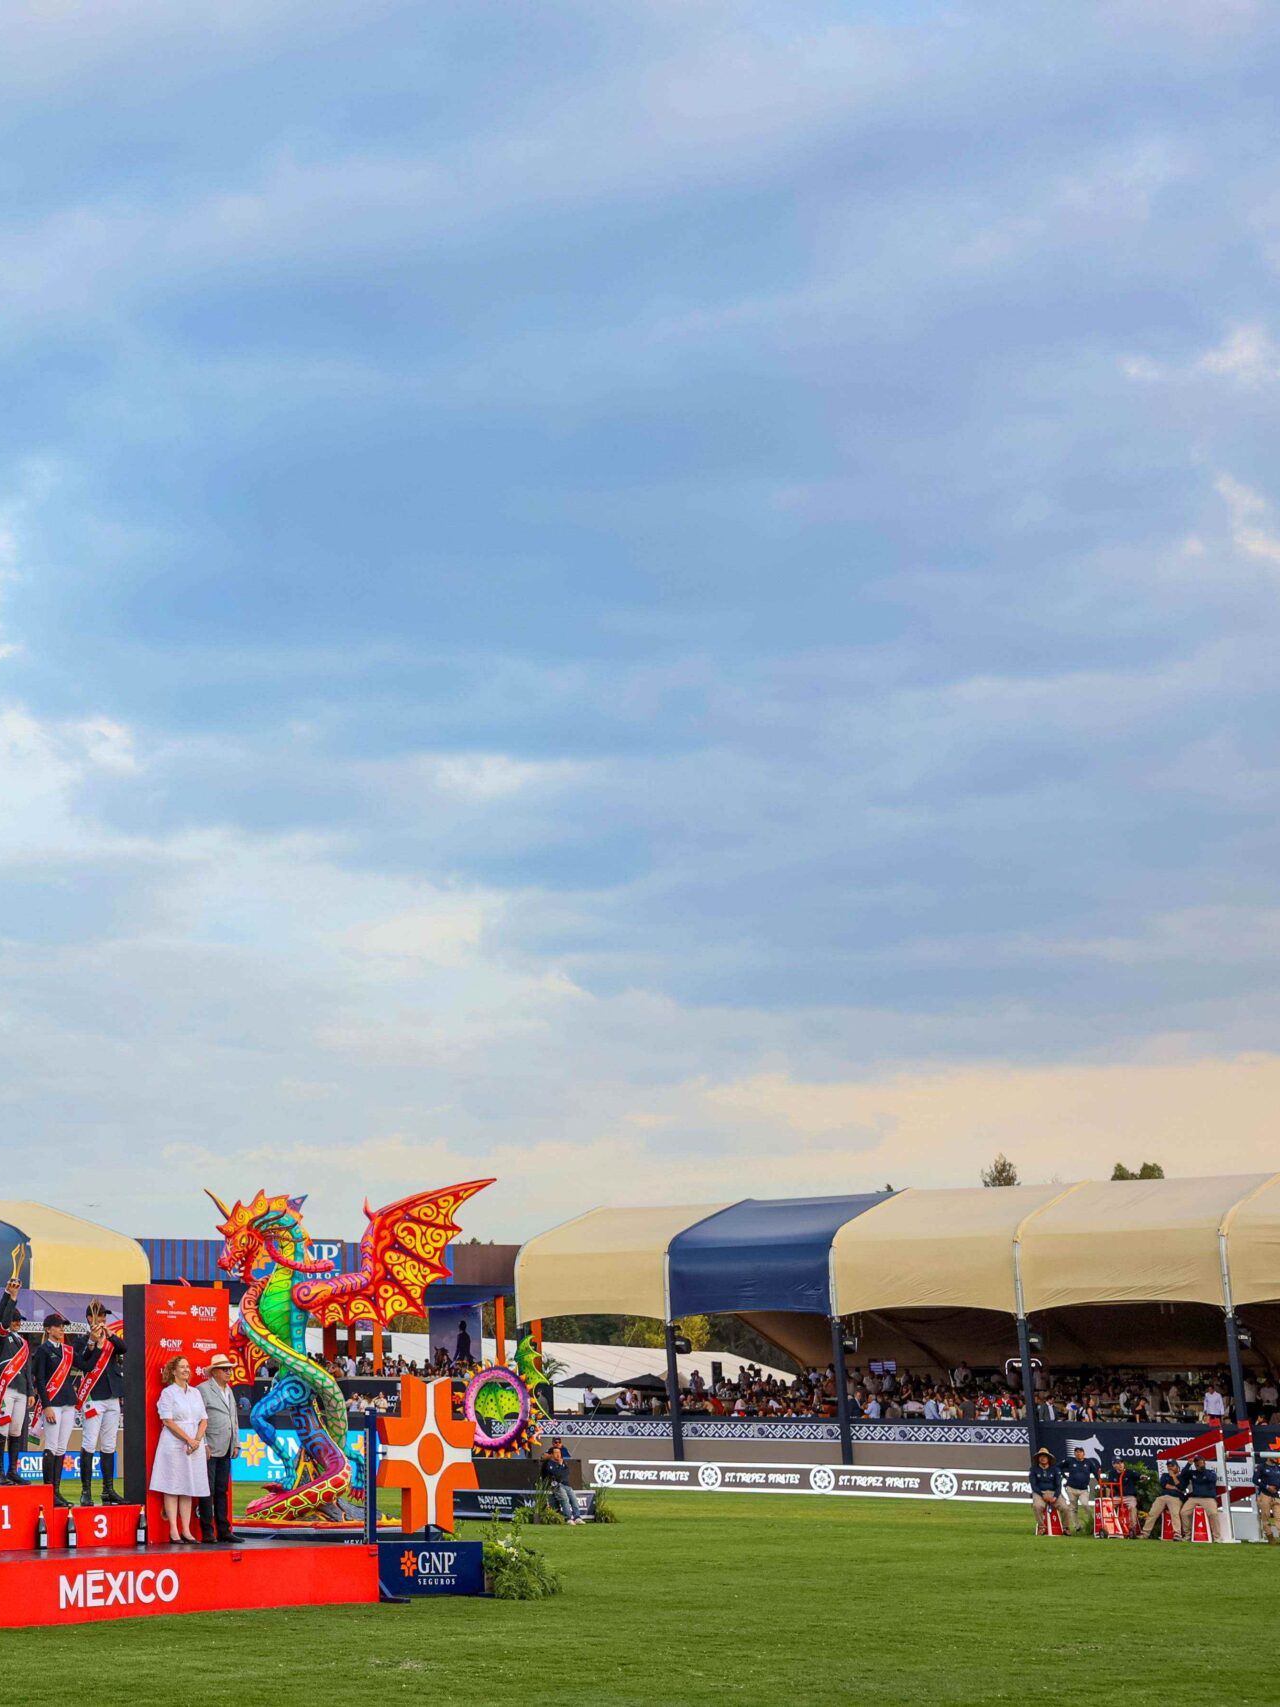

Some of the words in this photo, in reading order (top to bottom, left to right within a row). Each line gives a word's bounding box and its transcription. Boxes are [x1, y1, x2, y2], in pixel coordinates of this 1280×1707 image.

[199, 1306, 216, 1316] GNP
[167, 1339, 182, 1348] GNP
[1114, 1448, 1153, 1456] GLOBAL
[660, 1471, 690, 1482] PIRATES
[768, 1473, 800, 1484] PIRATES
[886, 1477, 920, 1488] PIRATES
[1012, 1481, 1032, 1494] PIRA
[478, 1496, 512, 1505] NAYARIT
[1, 1505, 11, 1530] 1
[94, 1514, 108, 1538] 3
[418, 1551, 454, 1574] GNP
